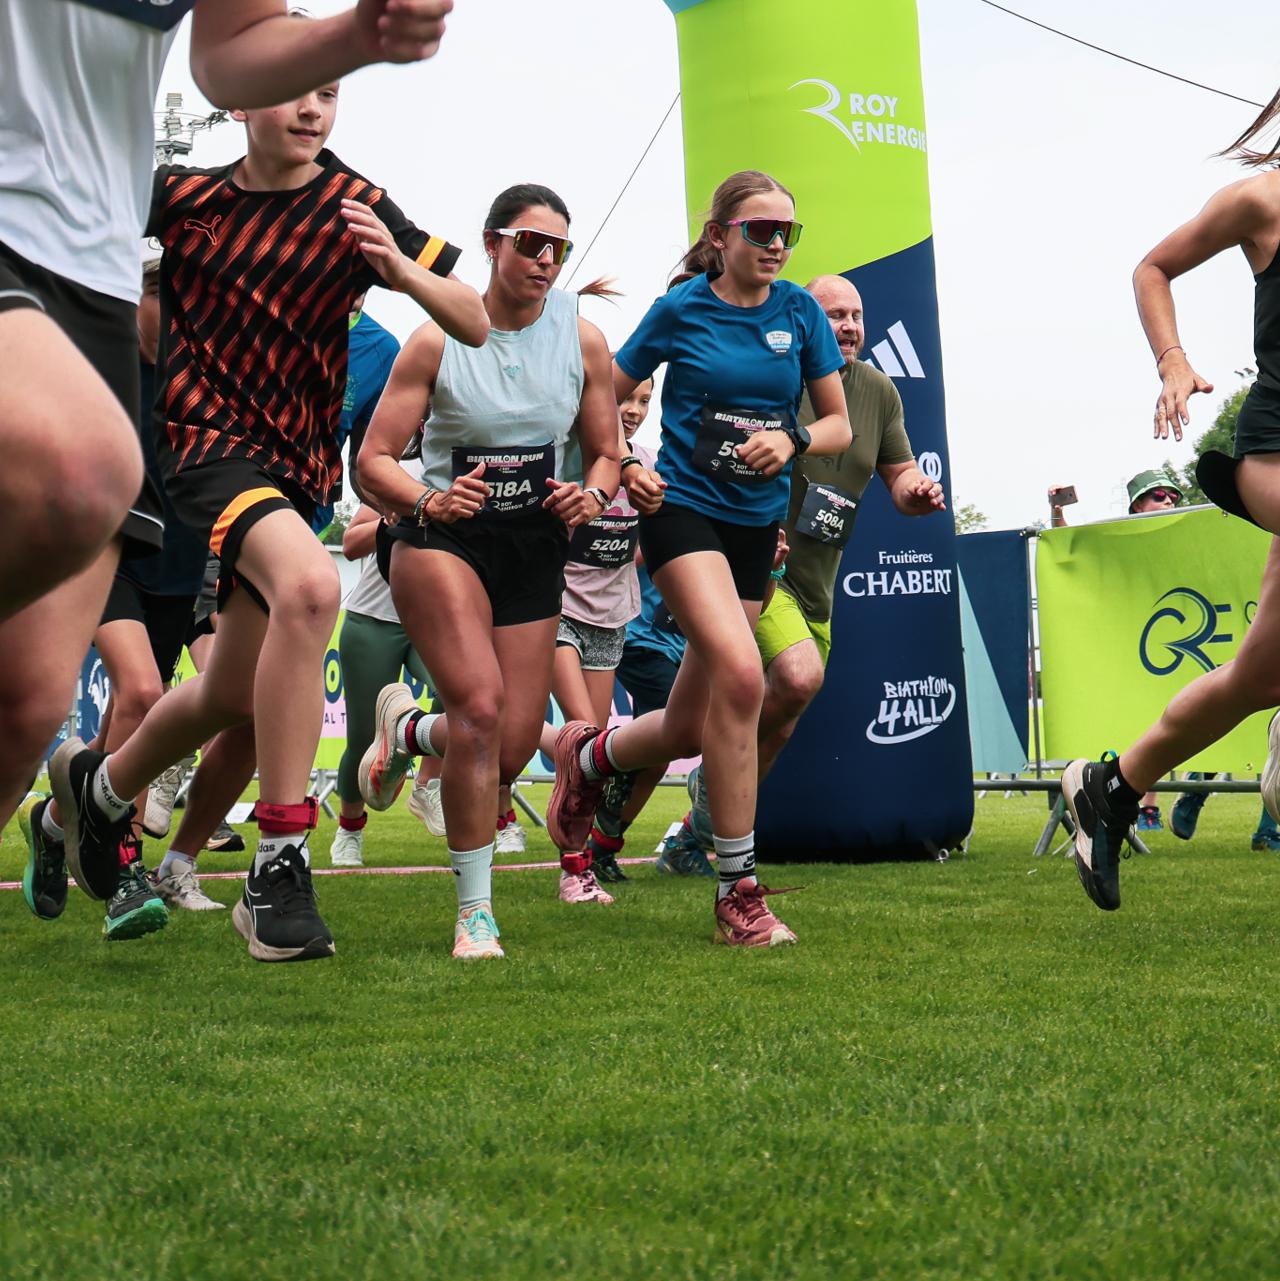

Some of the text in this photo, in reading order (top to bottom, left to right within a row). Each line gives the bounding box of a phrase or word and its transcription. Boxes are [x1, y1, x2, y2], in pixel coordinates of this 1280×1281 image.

[849, 93, 899, 118] ROY
[714, 412, 765, 428] BIATHLON
[764, 420, 782, 429] RUN
[466, 452, 545, 464] BIATHLON RUN
[815, 509, 845, 531] 508A
[590, 539, 630, 551] 520A
[878, 550, 934, 565] Fruitières
[842, 569, 952, 597] CHABERT
